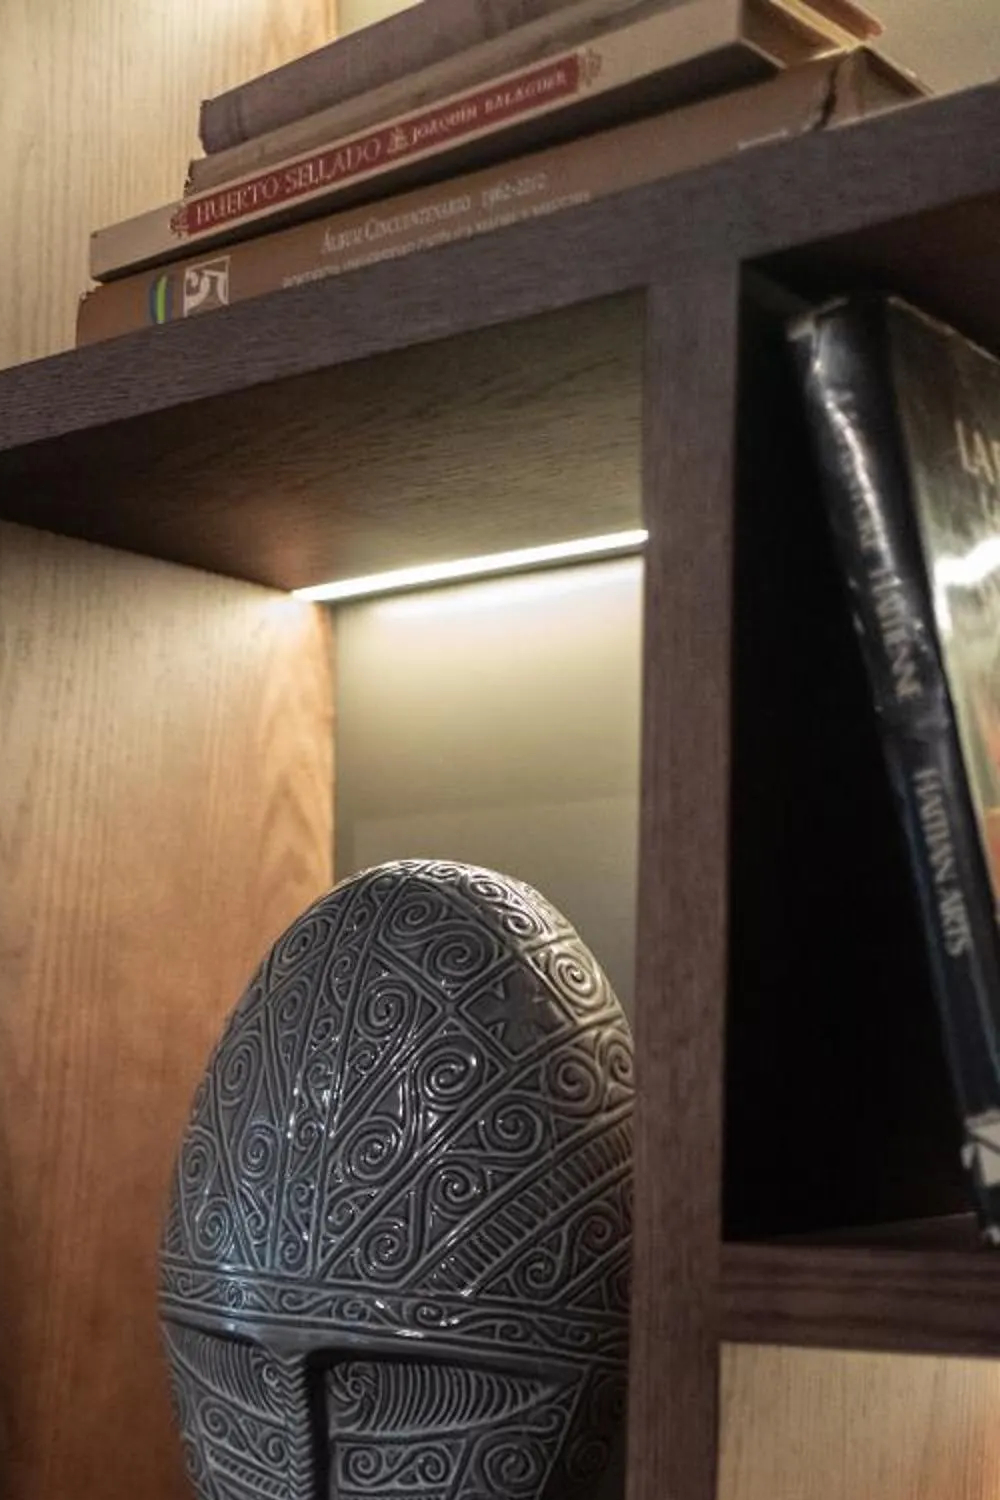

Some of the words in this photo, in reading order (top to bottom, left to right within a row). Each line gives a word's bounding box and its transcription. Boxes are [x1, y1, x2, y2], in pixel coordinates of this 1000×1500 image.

[196, 174, 280, 225] HUERTO
[284, 138, 382, 194] SELLADO
[913, 767, 957, 883] HAITIAN
[936, 884, 974, 958] ARTS
